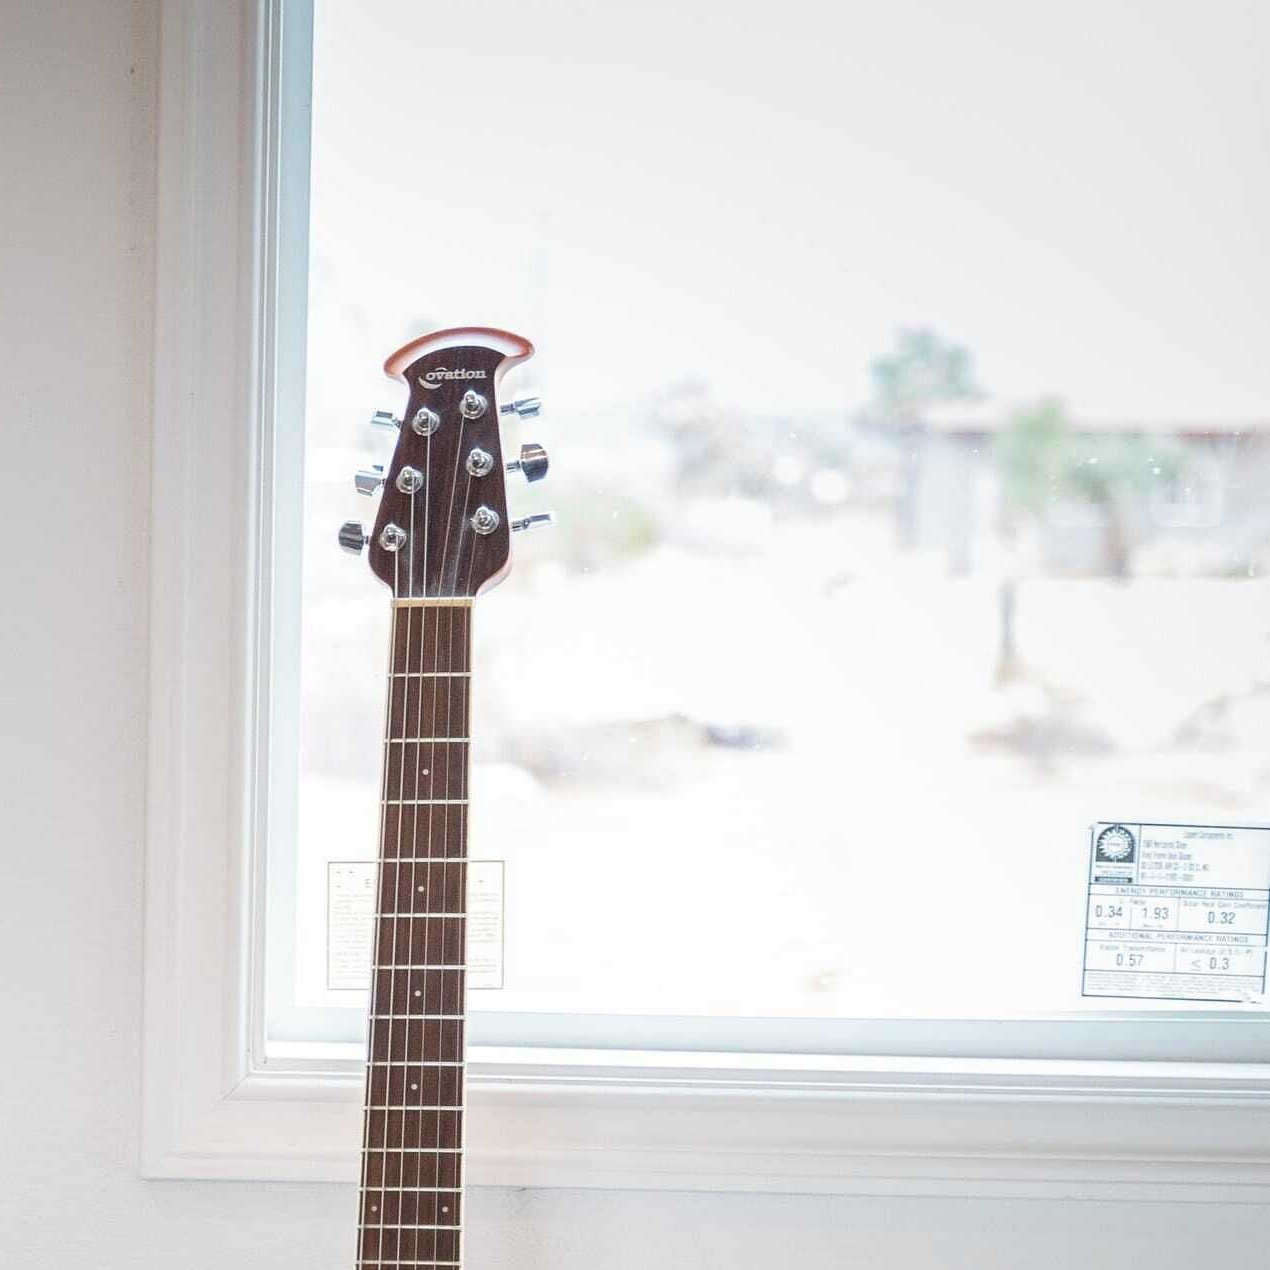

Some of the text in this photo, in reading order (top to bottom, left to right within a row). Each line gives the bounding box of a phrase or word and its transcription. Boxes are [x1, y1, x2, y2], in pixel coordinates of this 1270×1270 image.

[1095, 904, 1123, 919] 0.34
[1207, 910, 1236, 925] 0.32
[1116, 952, 1145, 968] 0.57
[1209, 956, 1230, 971] 0.3
